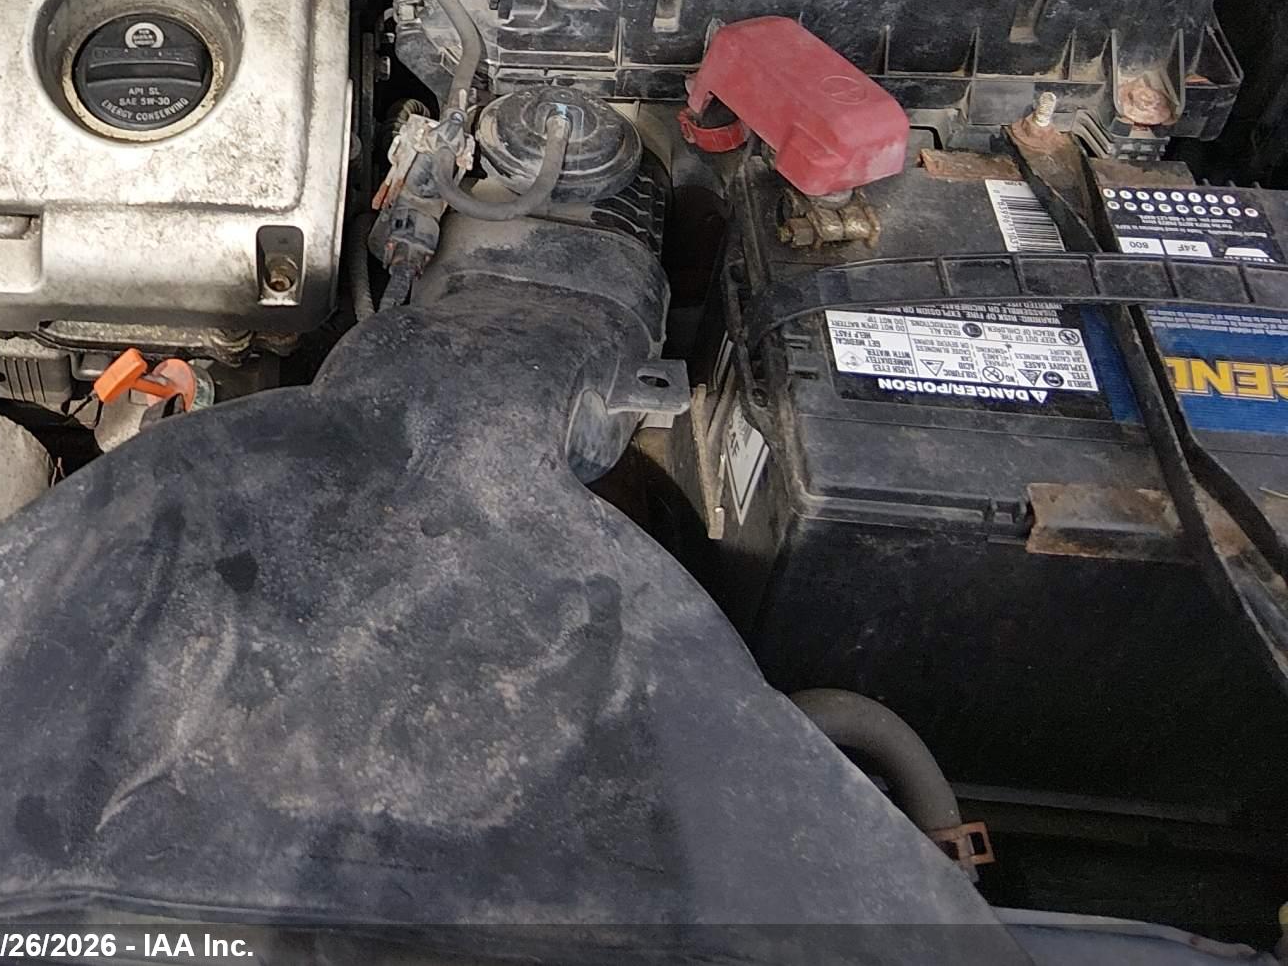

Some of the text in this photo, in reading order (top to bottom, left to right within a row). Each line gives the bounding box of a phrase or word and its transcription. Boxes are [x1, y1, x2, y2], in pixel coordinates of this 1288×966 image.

[128, 87, 161, 95] API SL
[119, 97, 170, 106] SAE 5W-30
[101, 97, 189, 121] ENERGY CONSERVING
[1177, 243, 1198, 252] 24F
[916, 307, 961, 318] EXPLOSION
[854, 331, 871, 340] HELP
[833, 337, 880, 348] GET MEDICAL
[893, 350, 910, 358] WITH
[866, 356, 912, 366] IMMEDIATELY
[872, 364, 915, 375] FLUSH EYES
[958, 362, 974, 370] ACID
[1023, 361, 1087, 372] EXPLOSIVE GASES
[943, 369, 977, 379] SULFURIC
[1005, 374, 1016, 383] NO
[1067, 380, 1093, 389] SHIELD
[878, 378, 1029, 401] DANGER/POISON
